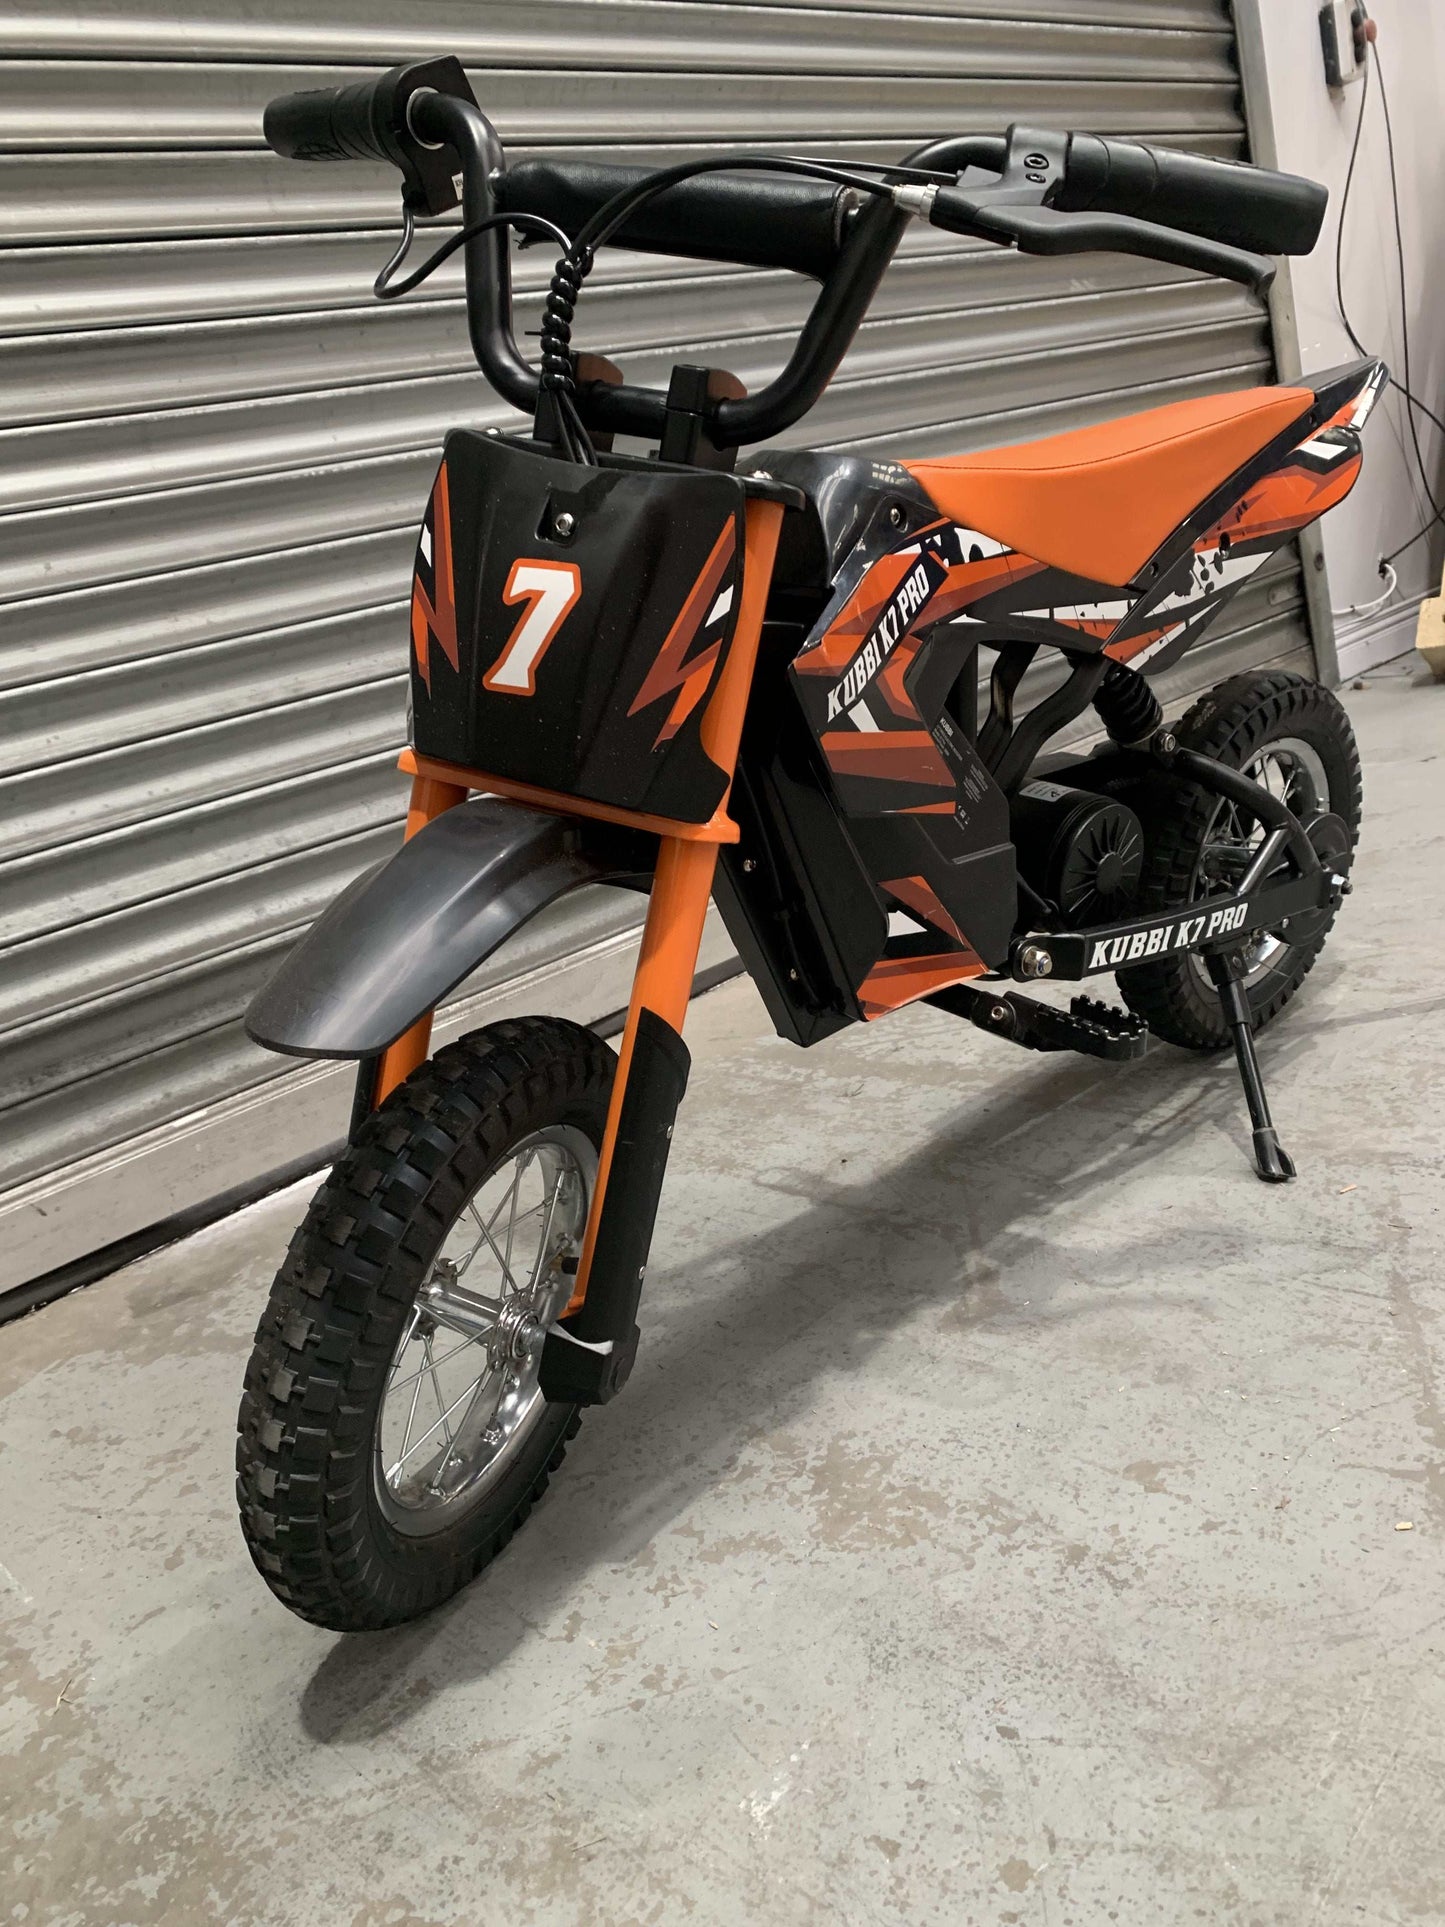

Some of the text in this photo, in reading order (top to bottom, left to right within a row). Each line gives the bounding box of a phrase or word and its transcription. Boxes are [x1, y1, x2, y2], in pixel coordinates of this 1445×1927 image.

[482, 558, 582, 697] 7
[827, 563, 930, 723] KUBBI K7 PRO
[1088, 902, 1248, 969] KUBBI K7 PRO
